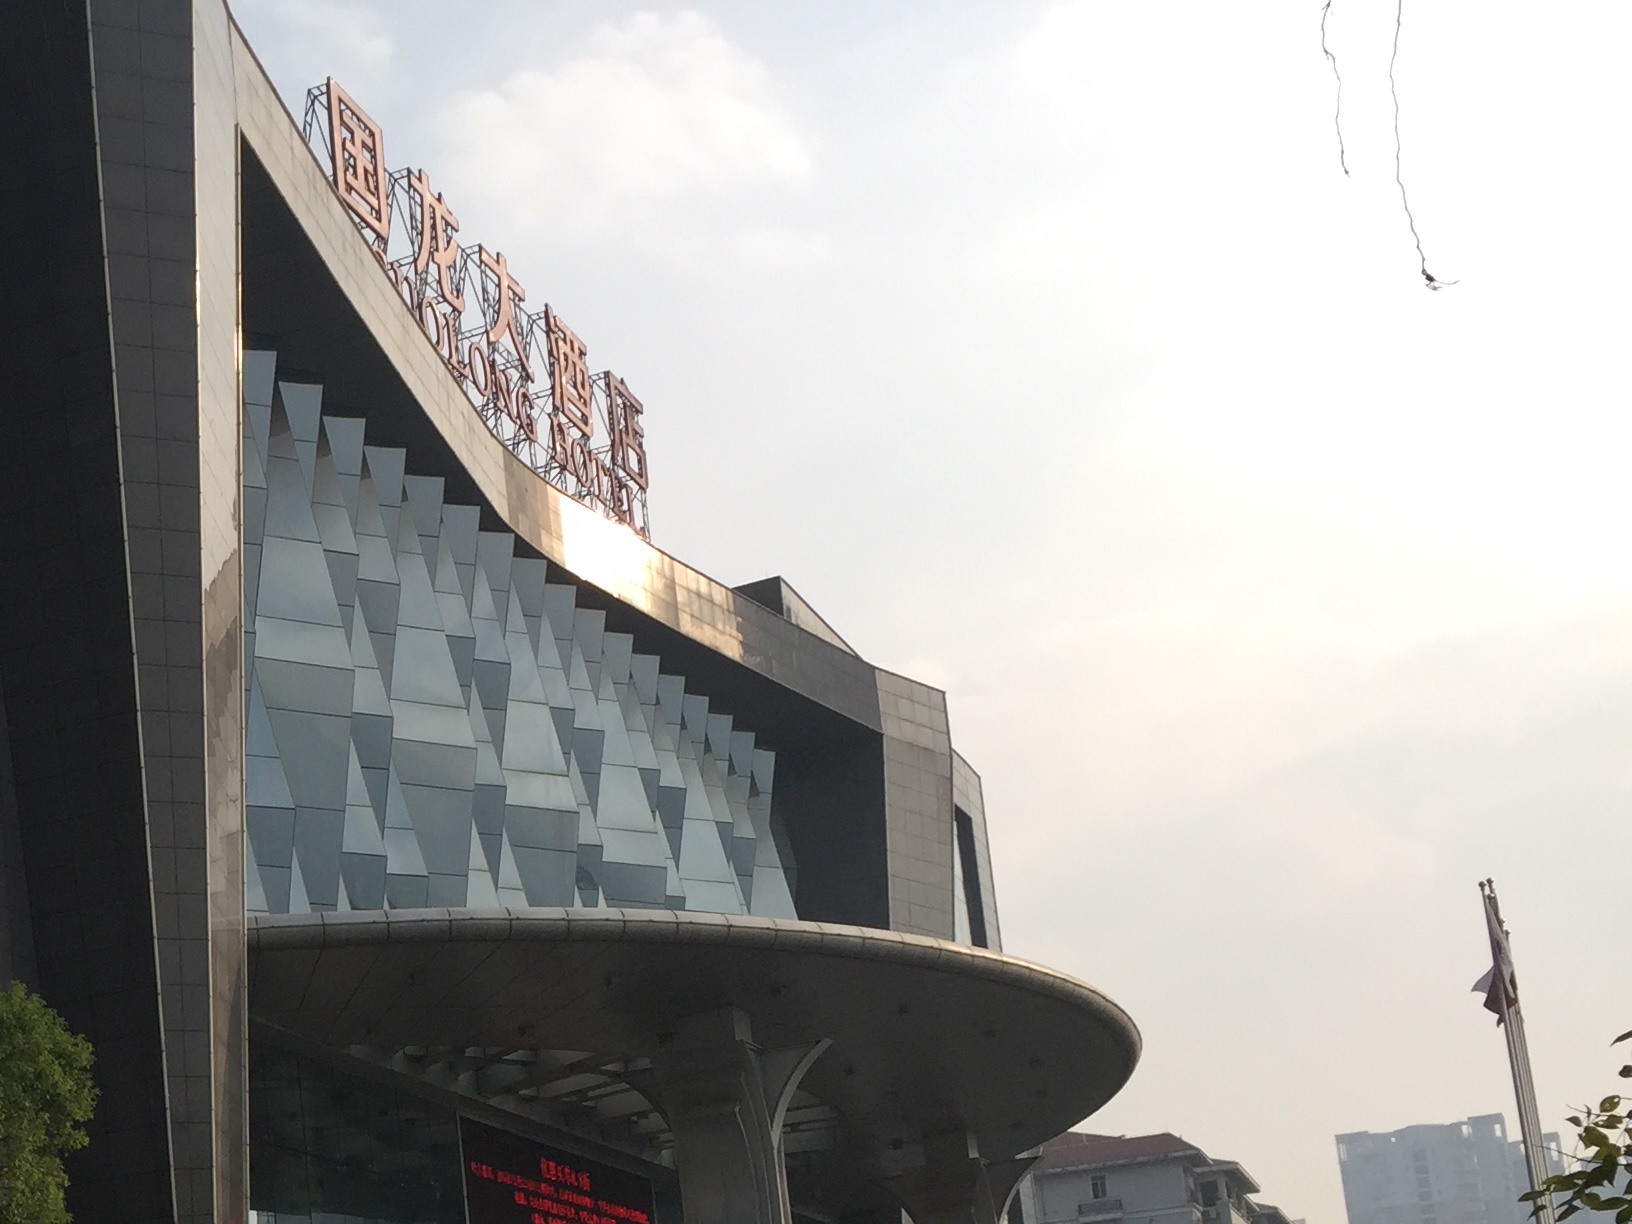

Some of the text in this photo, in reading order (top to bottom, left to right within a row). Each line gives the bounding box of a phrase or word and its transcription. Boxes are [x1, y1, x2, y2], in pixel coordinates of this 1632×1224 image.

[326, 75, 649, 490] 国龙大酒店
[371, 246, 647, 539] OLONG HOTEL
